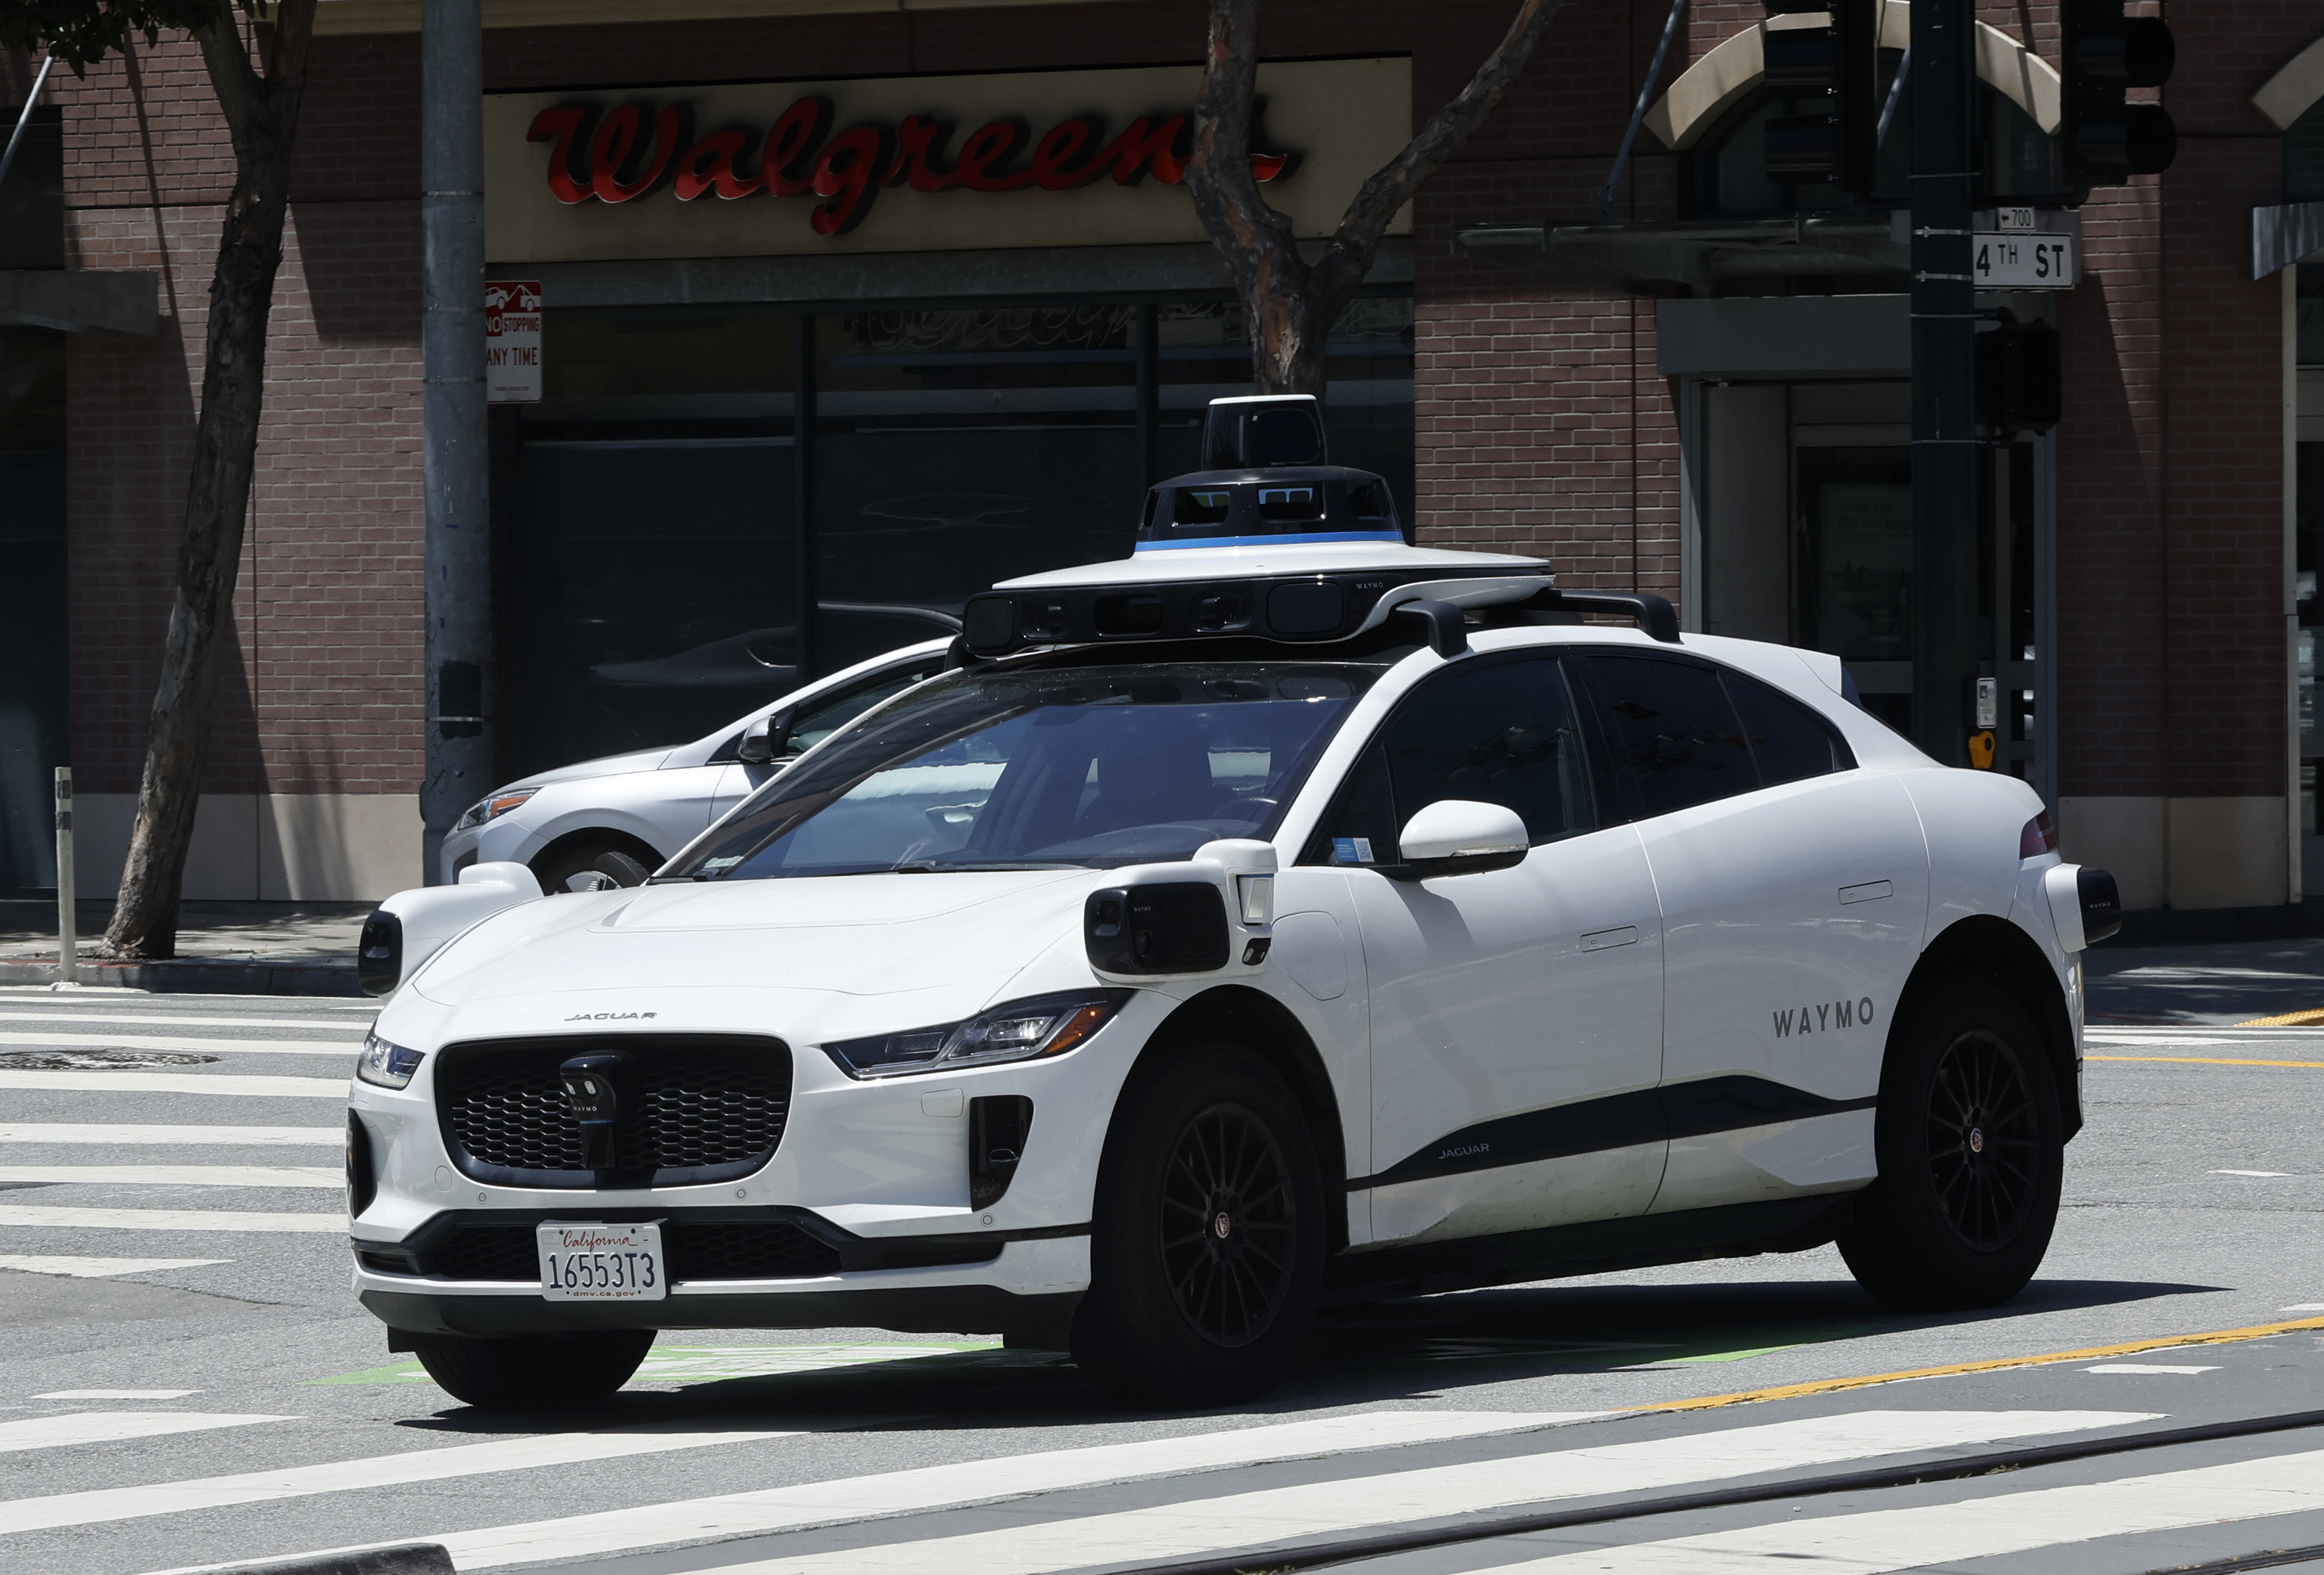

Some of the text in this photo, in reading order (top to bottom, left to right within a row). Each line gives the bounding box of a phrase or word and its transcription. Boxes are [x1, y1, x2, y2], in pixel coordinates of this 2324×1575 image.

[527, 96, 1288, 235] Walgreen
[2012, 210, 2030, 226] 700
[1976, 244, 2064, 278] 4TH ST
[504, 317, 539, 332] STOPPING
[486, 347, 538, 365] ANY TIME
[1873, 503, 1892, 517] up
[1838, 514, 1859, 528] the
[564, 1012, 657, 1021] JAGUAR
[1773, 996, 1874, 1038] WAYMO
[1438, 1142, 1490, 1160] JAGUAR
[563, 1230, 638, 1253] California
[548, 1253, 655, 1289] 16553T3
